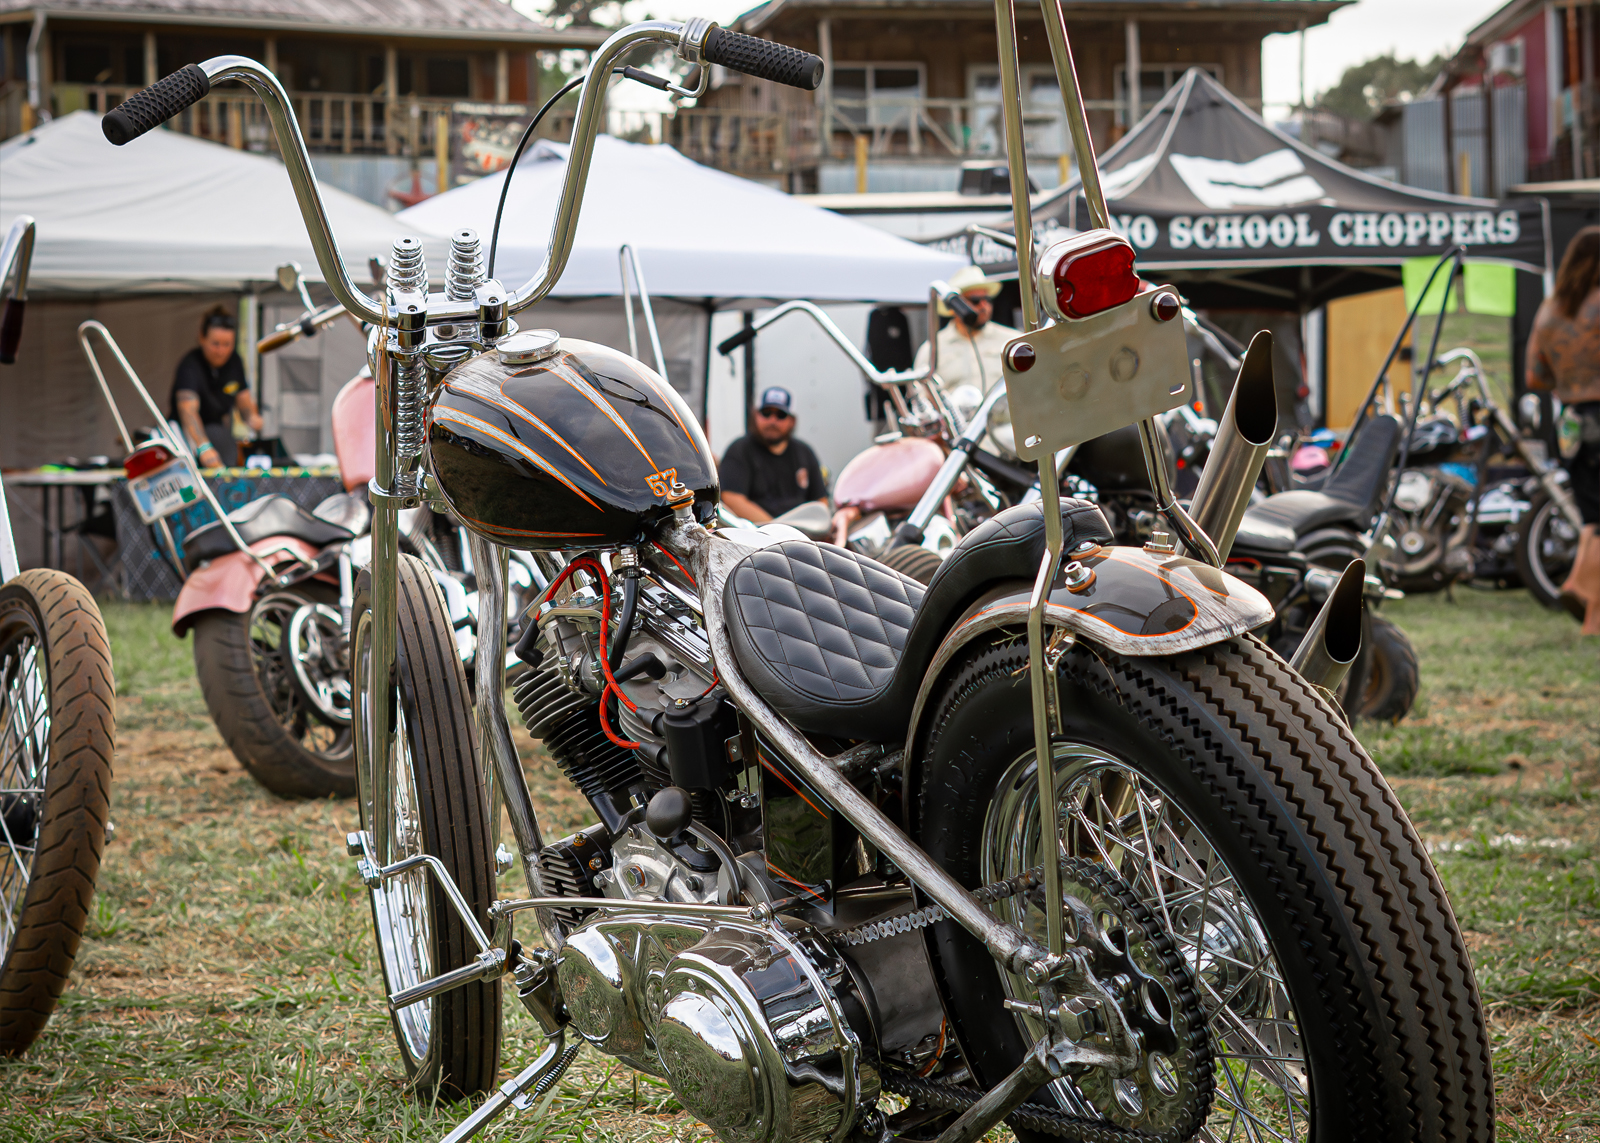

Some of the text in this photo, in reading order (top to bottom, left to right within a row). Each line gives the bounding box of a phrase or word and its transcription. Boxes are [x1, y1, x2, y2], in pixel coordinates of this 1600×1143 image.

[1169, 214, 1320, 249] SCHOOL
[1328, 210, 1521, 247] CHOPPERS
[644, 467, 677, 497] 57
